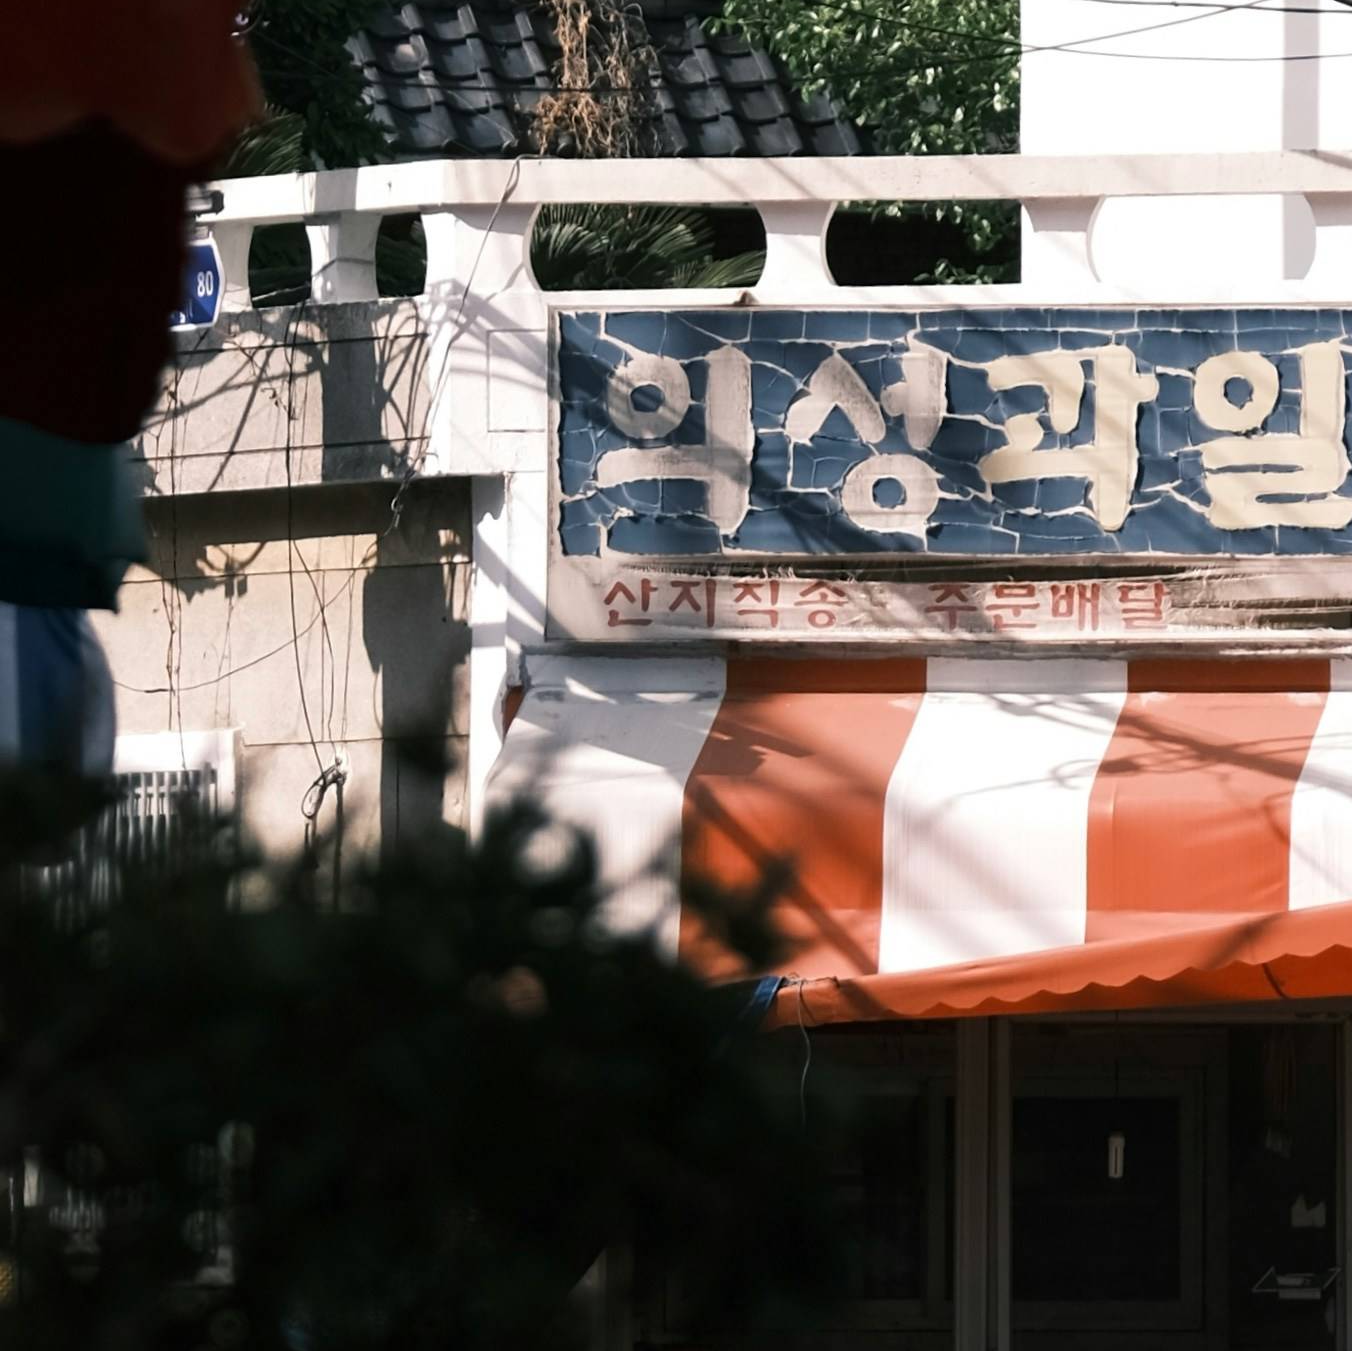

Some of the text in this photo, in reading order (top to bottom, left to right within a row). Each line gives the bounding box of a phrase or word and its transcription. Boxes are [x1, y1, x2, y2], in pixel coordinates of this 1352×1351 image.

[197, 270, 214, 298] 80
[603, 576, 1172, 633] 산지직송 주문배달
